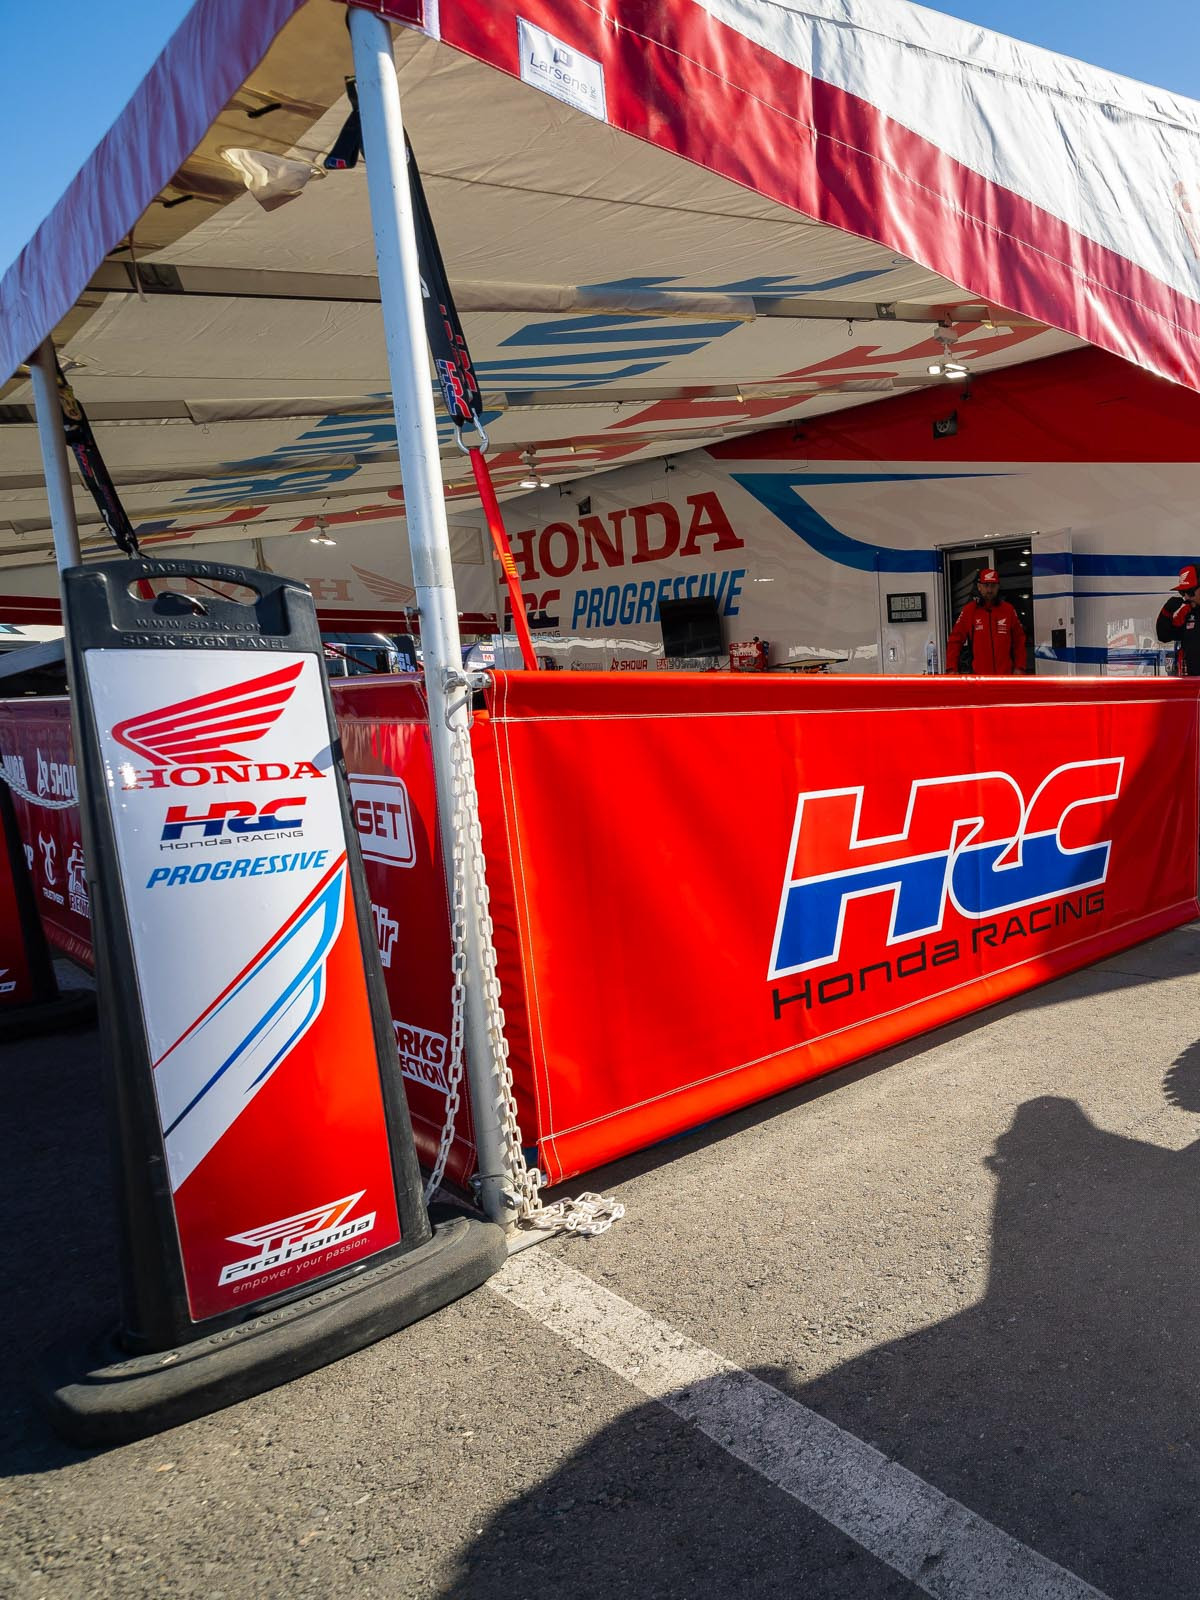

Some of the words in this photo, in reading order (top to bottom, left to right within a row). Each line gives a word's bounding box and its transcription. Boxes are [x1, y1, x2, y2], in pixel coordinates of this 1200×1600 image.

[530, 52, 588, 94] Larsens
[499, 491, 744, 584] HONDA
[142, 563, 186, 573] MADE
[193, 563, 211, 574] IN
[217, 565, 248, 581] USA
[123, 634, 176, 647] SD2K
[182, 635, 229, 648] SIGN
[235, 637, 289, 650] PANEL
[620, 659, 648, 670] SHOWA
[120, 761, 326, 790] HONDA
[160, 797, 307, 841] HRC
[355, 800, 401, 840] GET
[160, 838, 232, 851] Honda
[237, 830, 304, 844] RACING
[146, 850, 329, 888] PROGRESSIVE
[766, 756, 1125, 982] HRC
[771, 939, 959, 1021] Honda
[971, 889, 1105, 953] RACING
[395, 1027, 444, 1064] RKS
[400, 1054, 447, 1089] ECTION
[225, 1254, 281, 1280] Pro
[286, 1218, 372, 1258] Honda
[232, 1267, 292, 1294] empower
[297, 1254, 322, 1273] your
[326, 1237, 371, 1262] passion.
